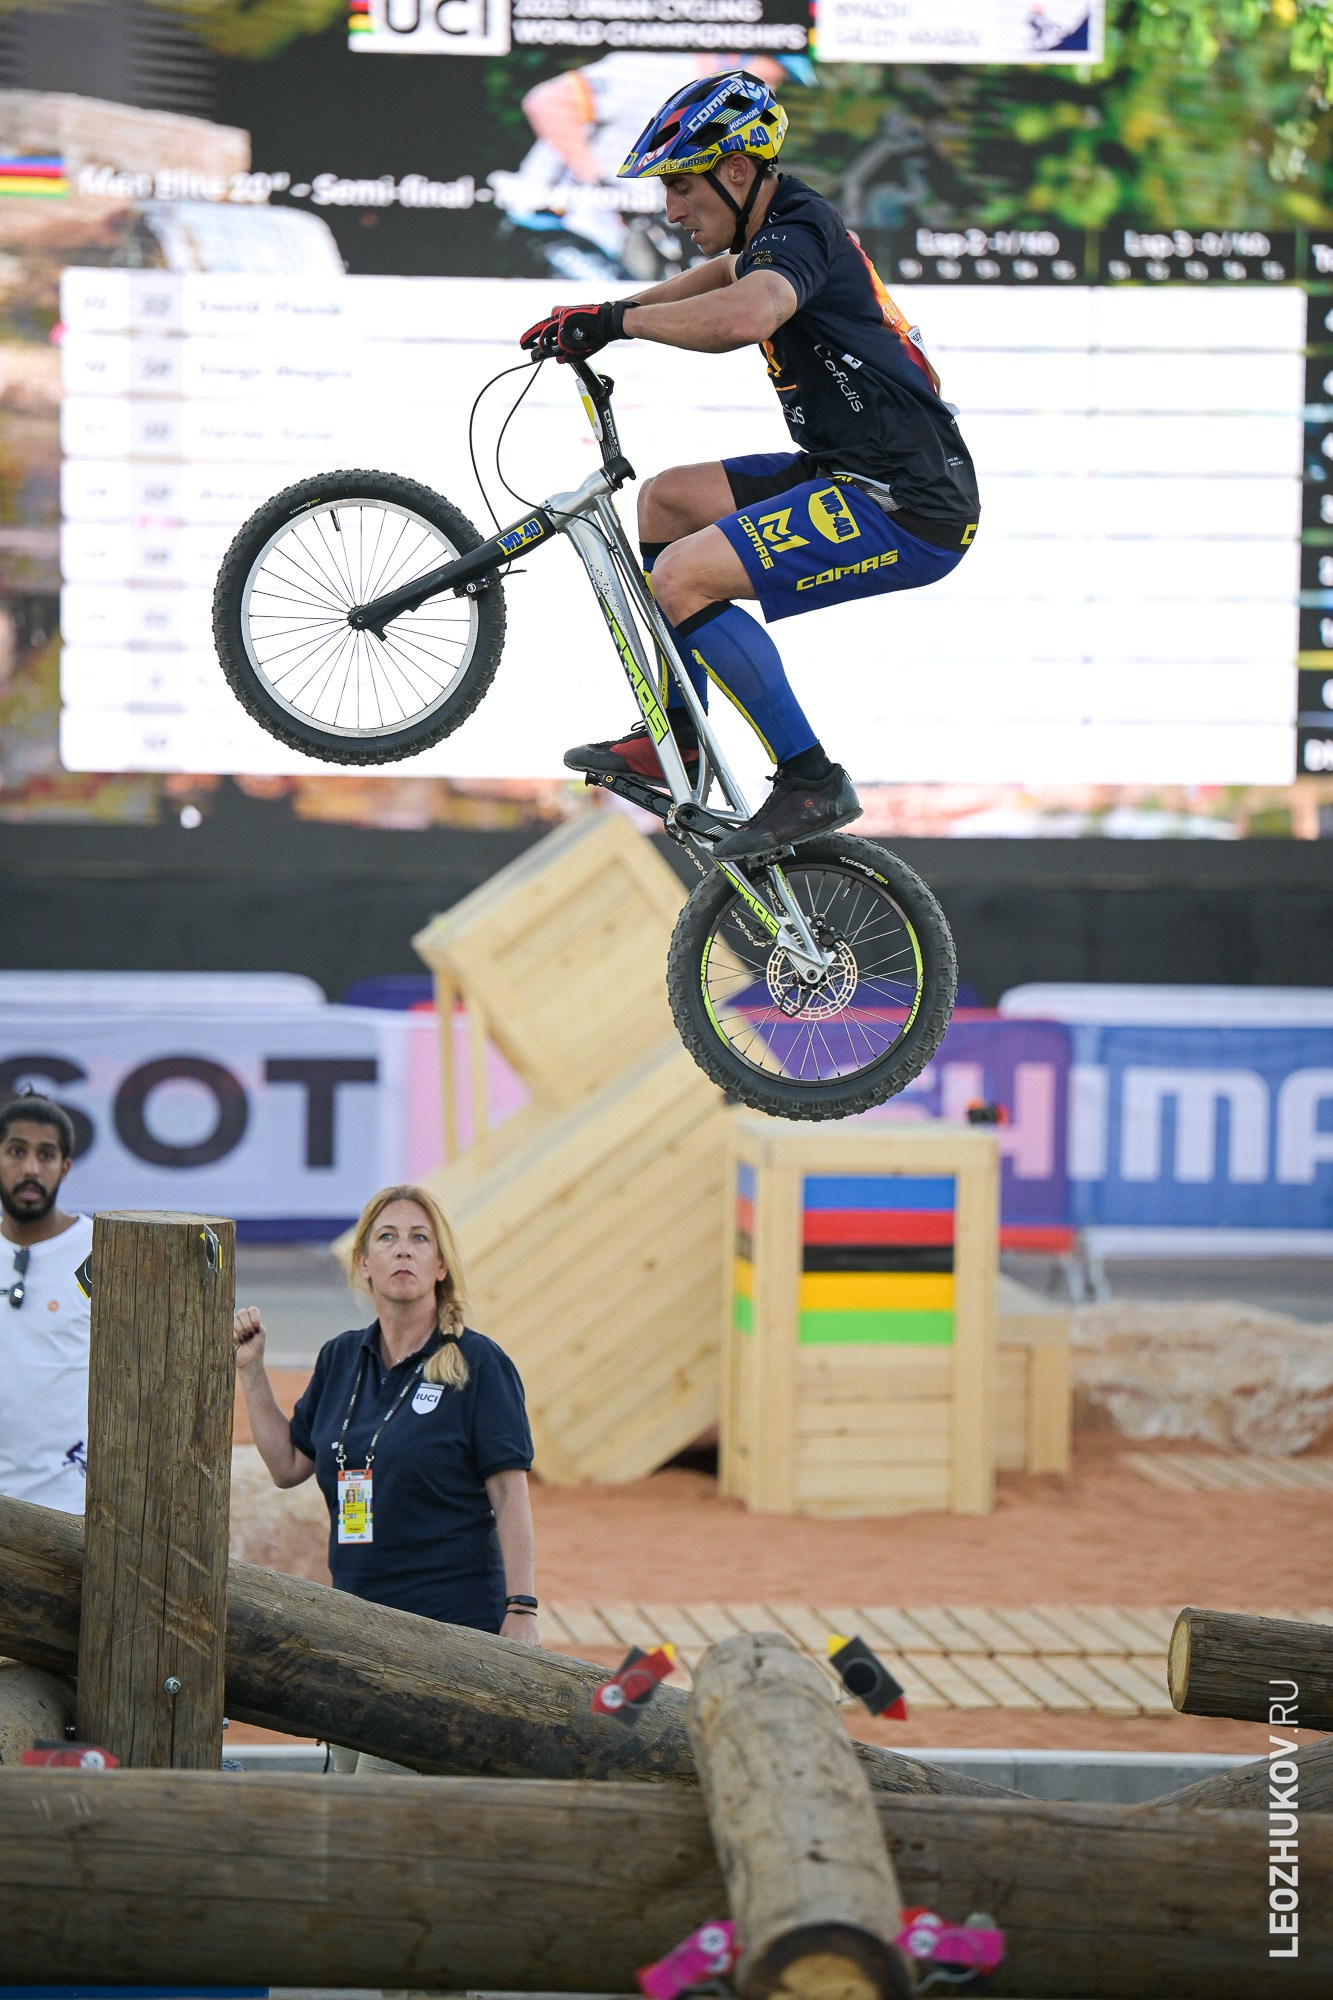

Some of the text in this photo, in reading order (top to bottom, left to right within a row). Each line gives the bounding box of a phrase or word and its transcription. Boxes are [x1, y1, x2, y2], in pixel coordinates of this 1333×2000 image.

[386, 0, 488, 35] UCI
[512, 19, 808, 50] WORLD CHAMPIONSHIPS
[729, 107, 760, 133] MUCHMORE
[717, 125, 770, 154] WD-40
[311, 172, 475, 209] Semi-final
[814, 343, 864, 413] Cofidis
[819, 489, 855, 540] WD-40
[498, 520, 542, 552] WD-40
[737, 515, 775, 570] COMAS
[796, 550, 898, 592] COMAS
